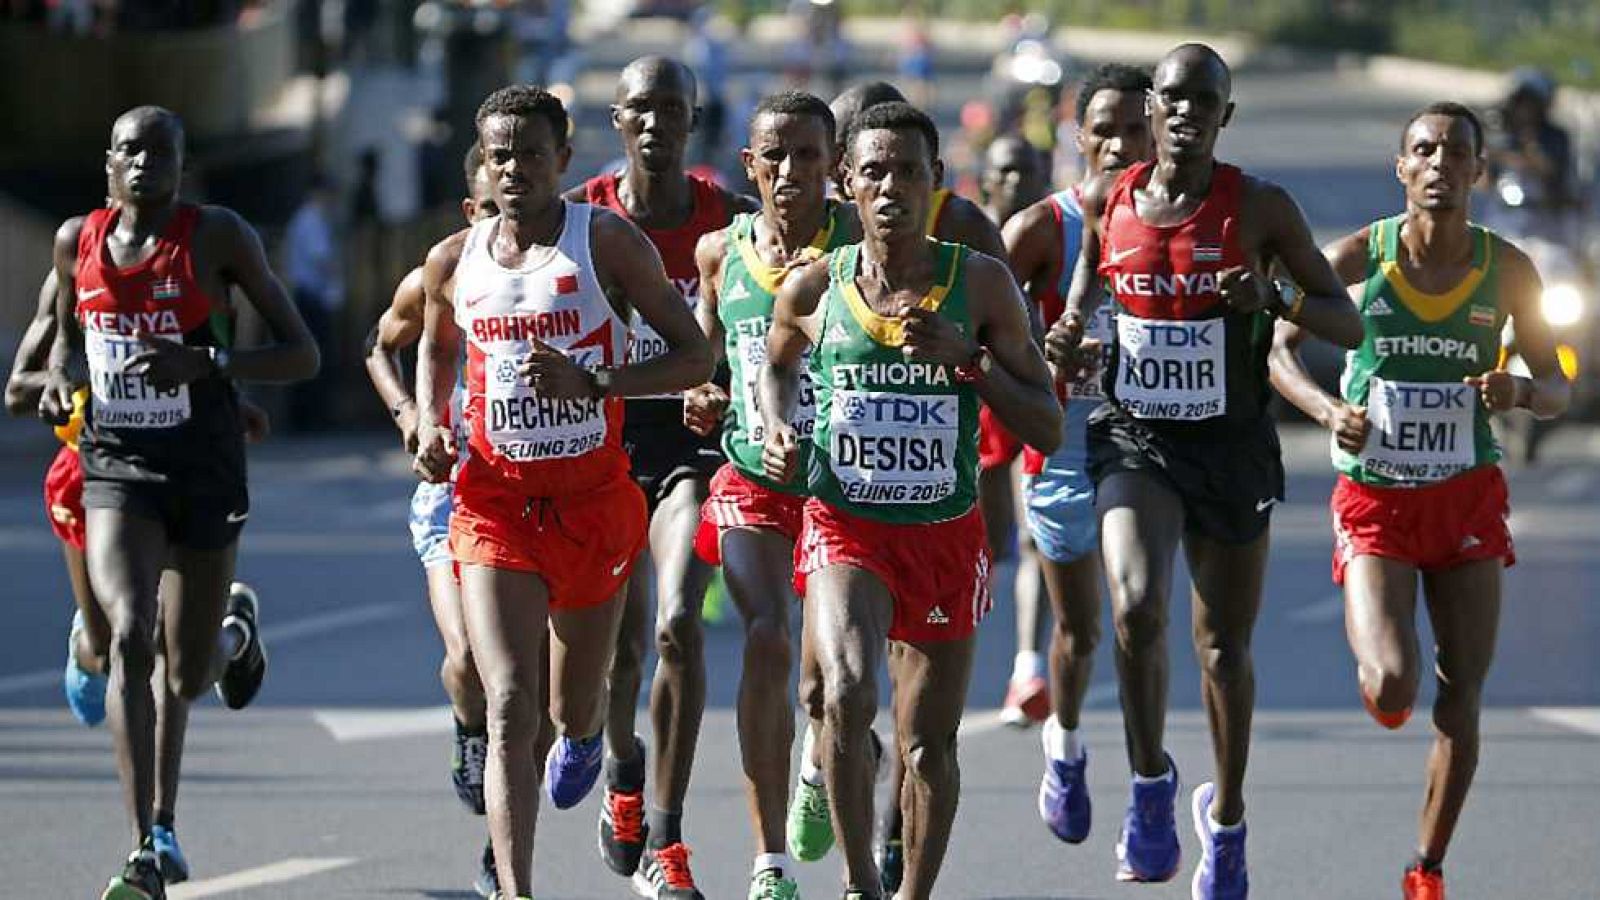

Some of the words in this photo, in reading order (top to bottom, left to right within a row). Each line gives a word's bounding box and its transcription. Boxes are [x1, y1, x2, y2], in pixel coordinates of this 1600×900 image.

[1114, 272, 1219, 296] KENYA
[85, 309, 179, 335] KENYA
[472, 309, 580, 342] BAHRAIN
[1143, 324, 1213, 347] TDK
[1374, 334, 1479, 364] ETHIOPIA
[832, 362, 949, 389] ETHIOPIA
[1123, 354, 1215, 390] KORIR
[1184, 400, 1219, 417] 2015
[1398, 386, 1467, 409] TDK
[491, 396, 599, 431] DECHASA
[867, 398, 946, 425] TDK
[1380, 422, 1457, 452] LEMI
[838, 433, 948, 471] DESISA
[910, 481, 950, 500] 2015
